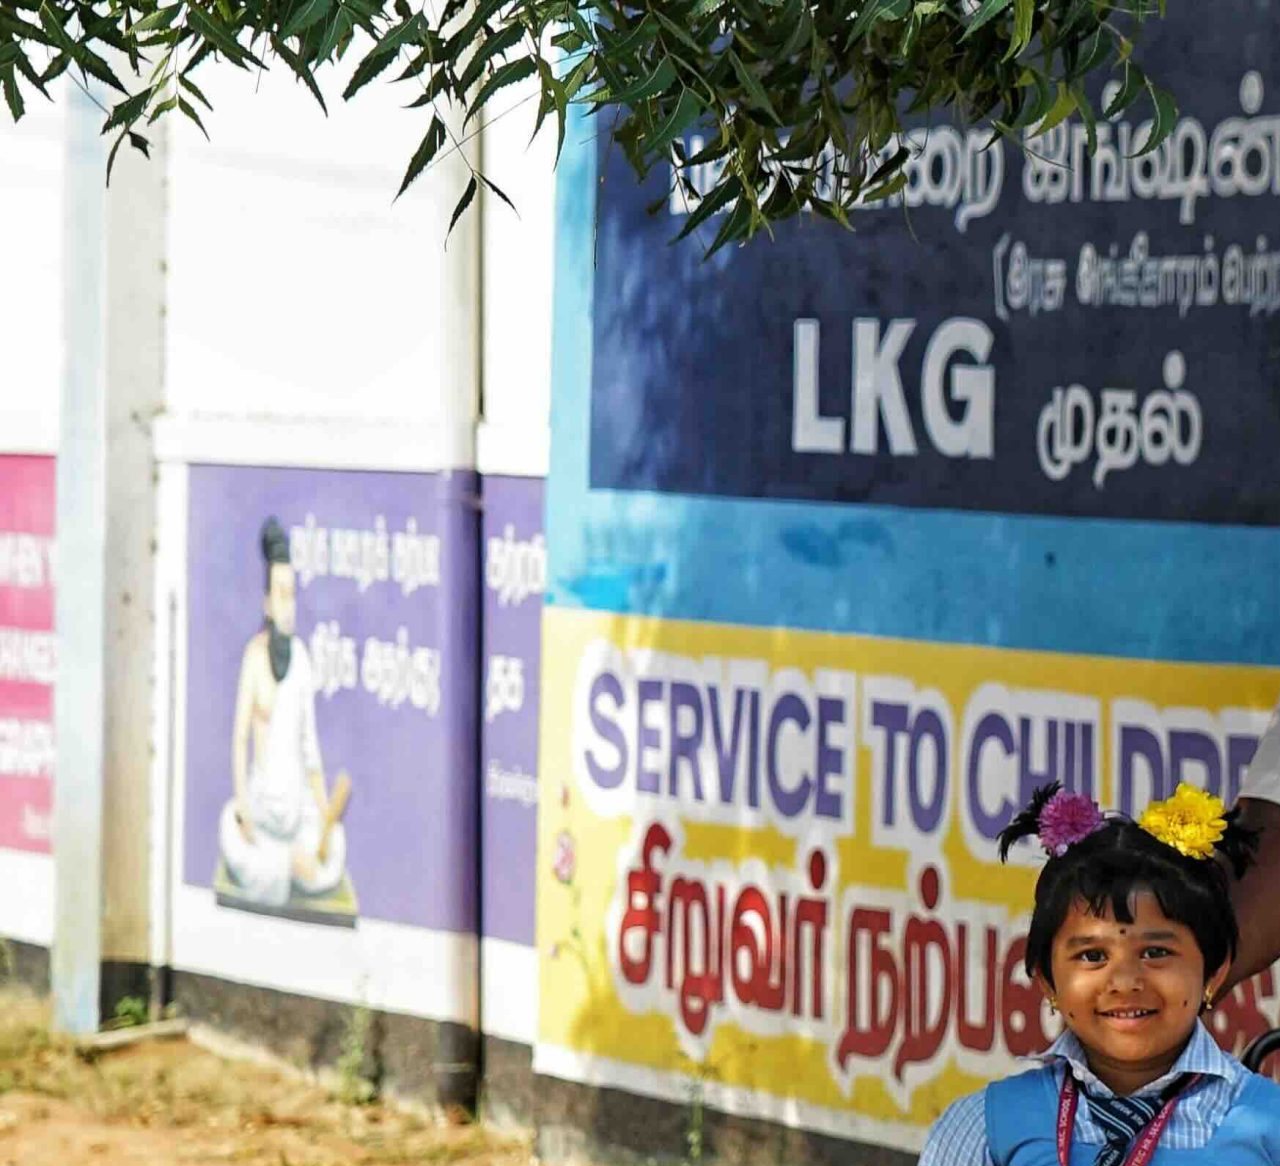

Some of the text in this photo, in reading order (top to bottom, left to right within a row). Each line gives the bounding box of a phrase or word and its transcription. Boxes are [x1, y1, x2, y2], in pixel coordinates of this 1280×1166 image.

[791, 316, 996, 459] LKG
[1036, 349, 1203, 489] முதல்
[584, 670, 847, 817] SERVICE
[869, 701, 951, 833] TO
[619, 822, 828, 1035] சிறுவர்
